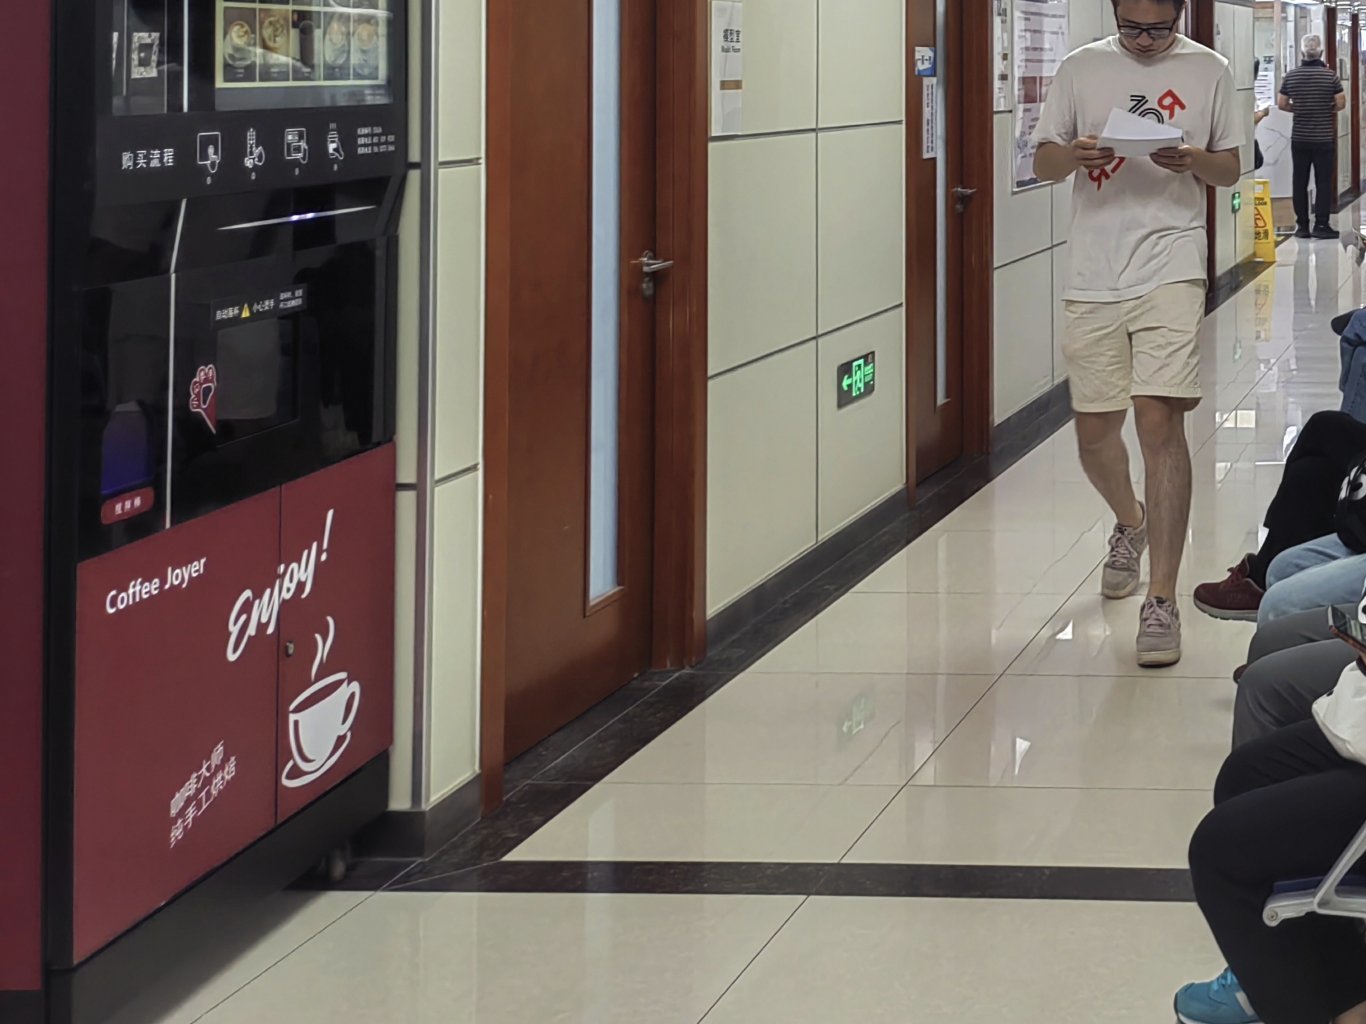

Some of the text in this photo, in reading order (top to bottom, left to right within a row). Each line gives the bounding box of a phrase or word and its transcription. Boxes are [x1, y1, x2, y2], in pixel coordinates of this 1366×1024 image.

[121, 149, 174, 170] 购买流程
[105, 556, 207, 615] Coffee Joyer
[226, 508, 335, 662] Enjoy!
